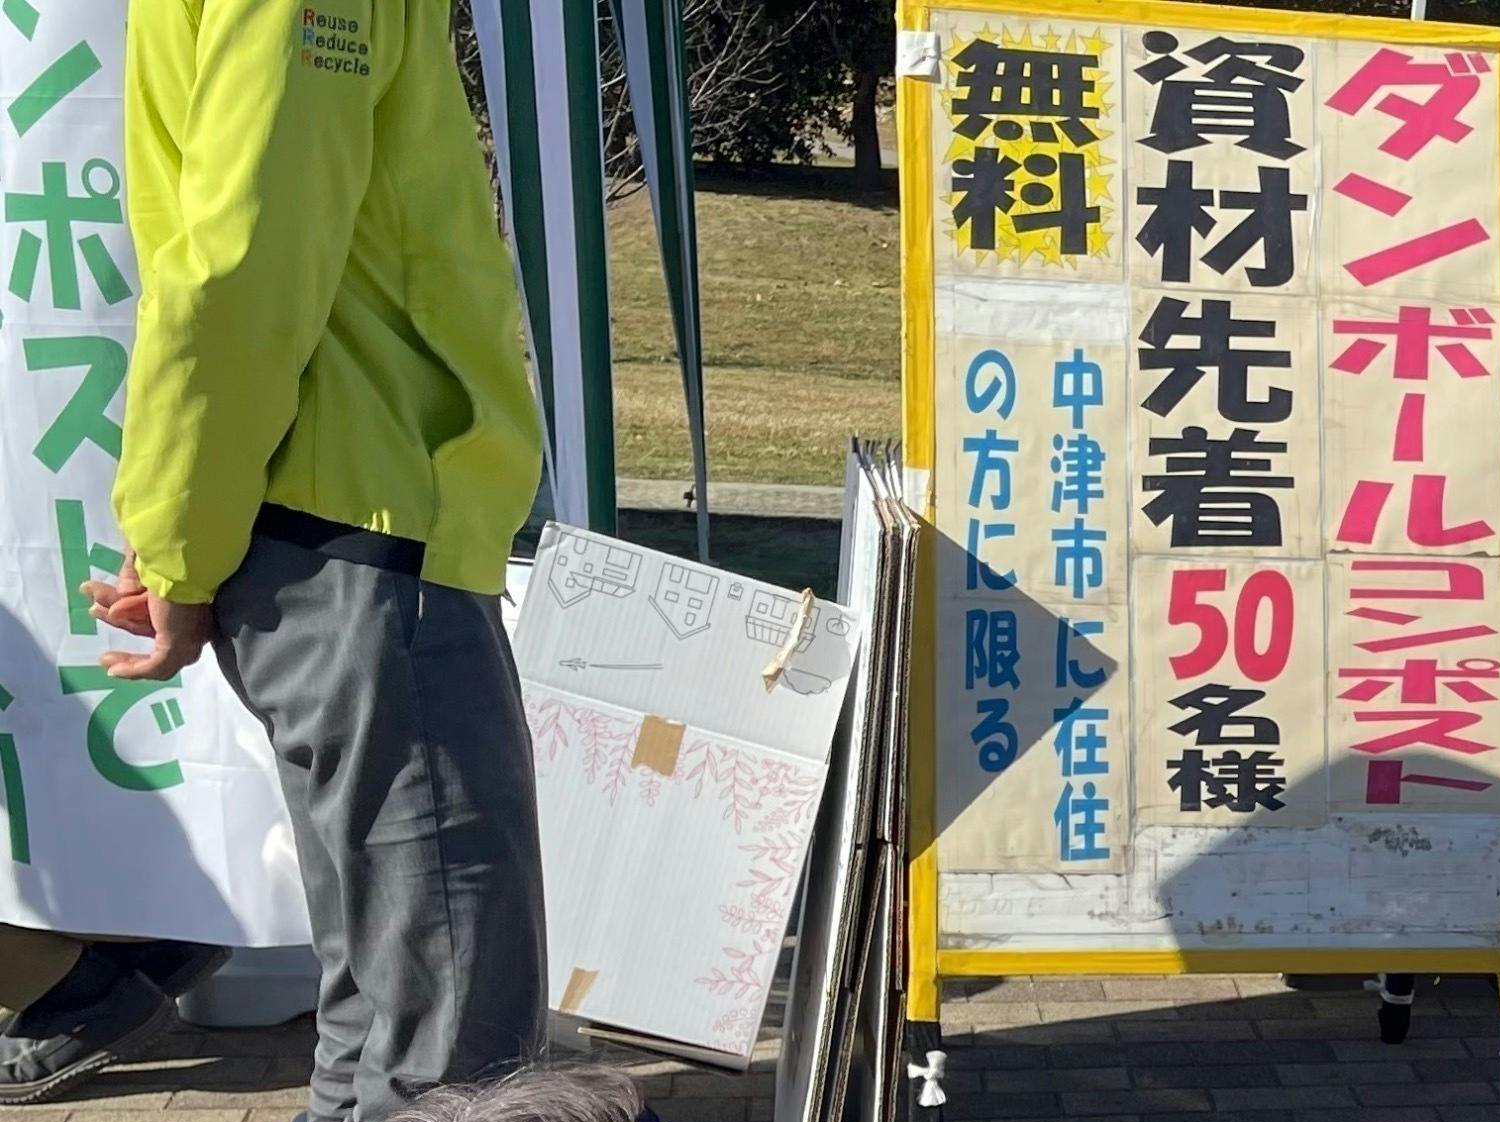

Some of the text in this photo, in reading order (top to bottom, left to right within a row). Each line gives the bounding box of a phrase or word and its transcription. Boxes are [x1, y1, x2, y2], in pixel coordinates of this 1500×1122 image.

[301, 49, 370, 76] Recycle
[302, 27, 368, 55] Reduce
[303, 8, 358, 33] Reuse
[950, 38, 1101, 256] 無料
[962, 348, 1021, 774] の方に限る
[1050, 347, 1111, 863] 中津市に在住
